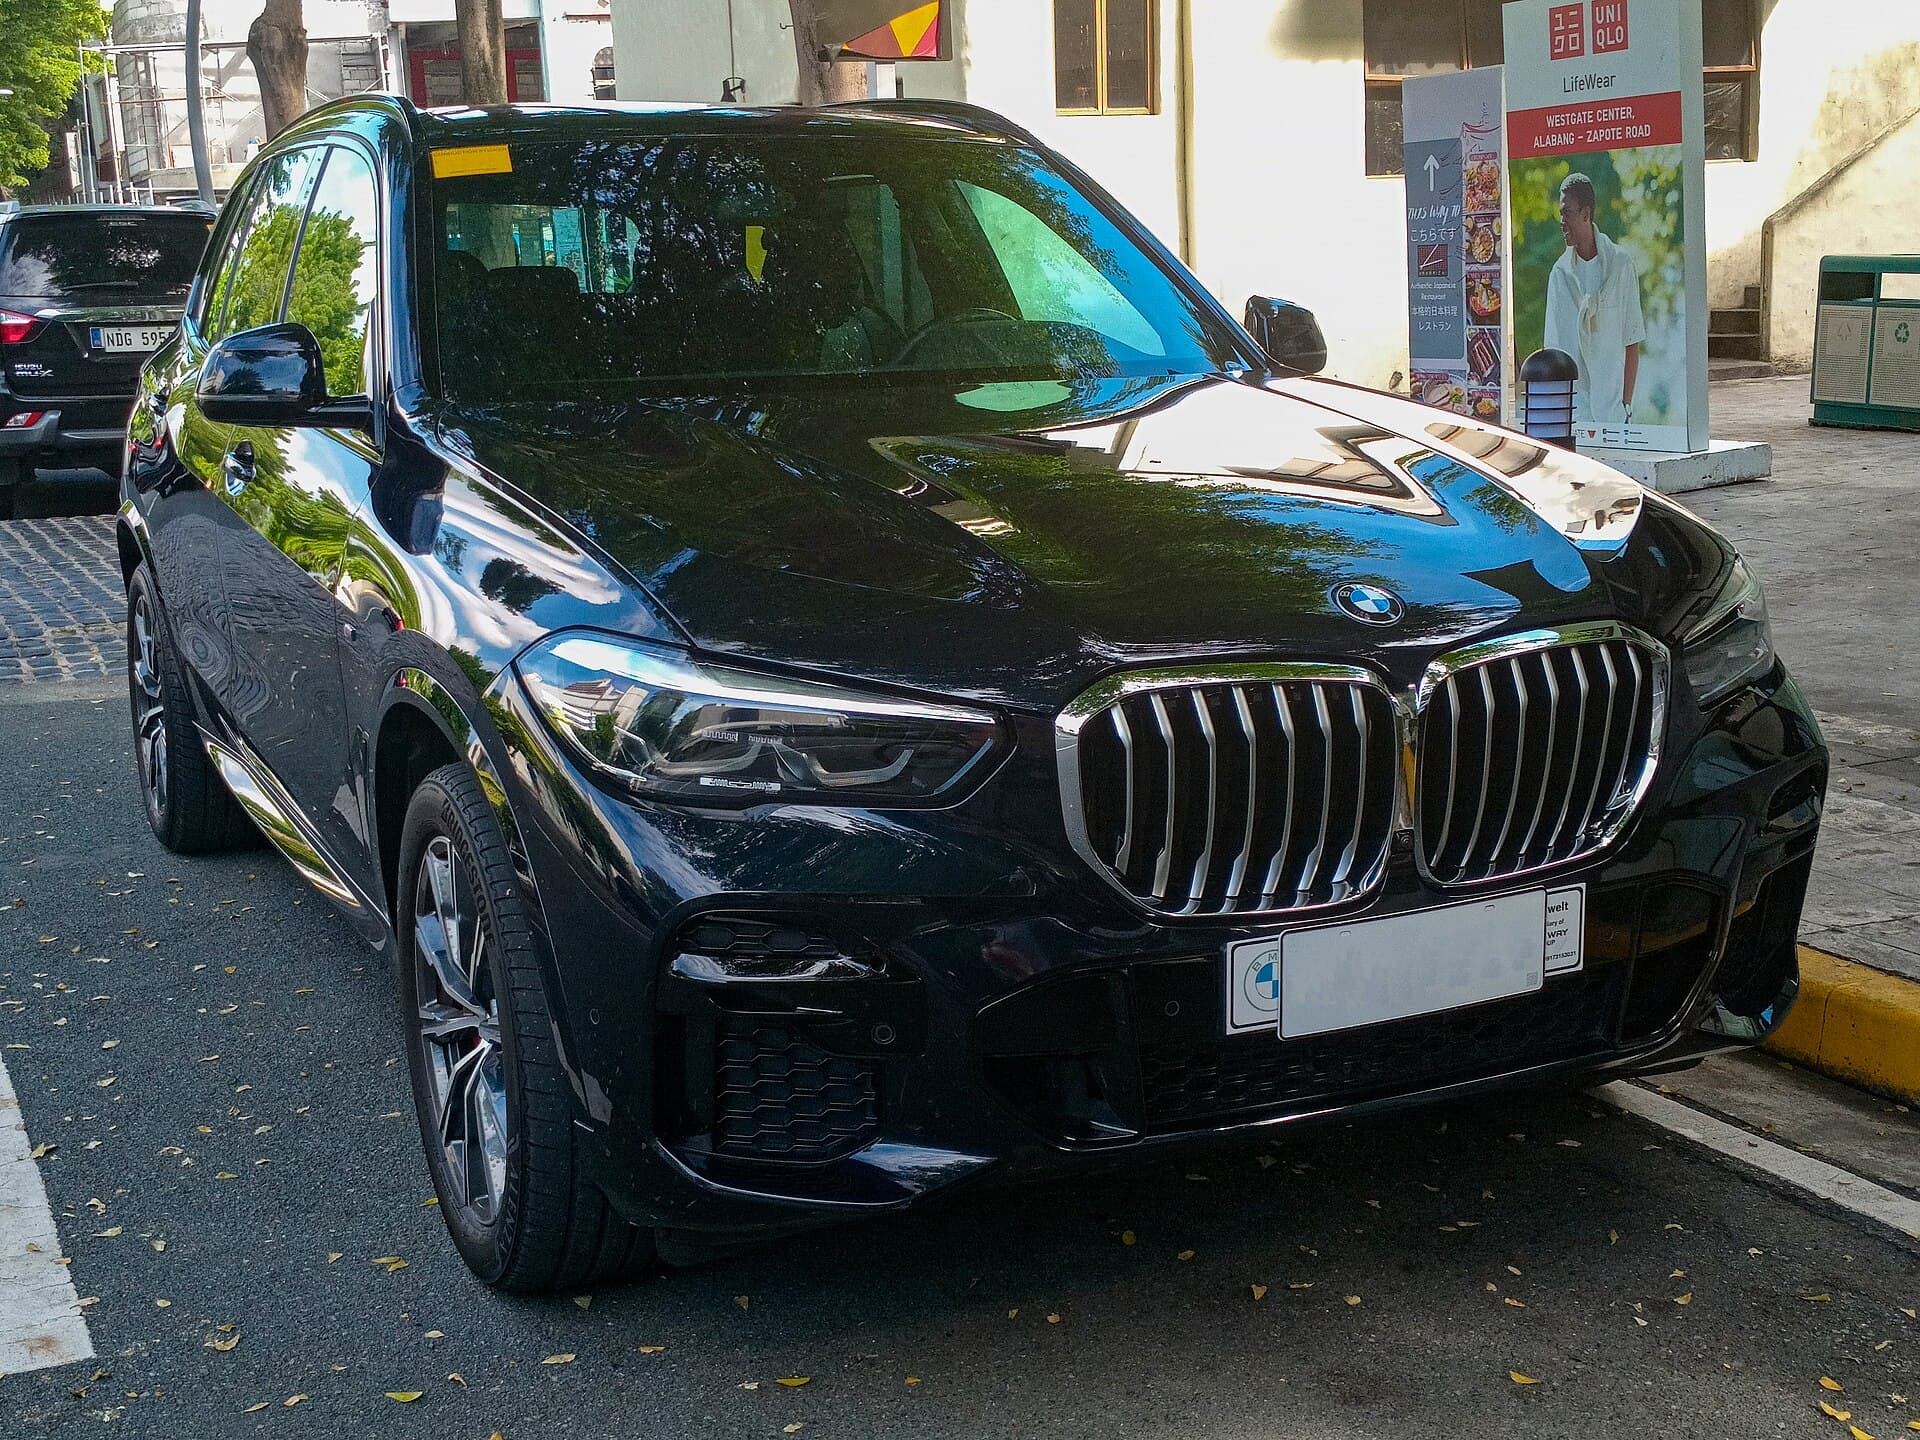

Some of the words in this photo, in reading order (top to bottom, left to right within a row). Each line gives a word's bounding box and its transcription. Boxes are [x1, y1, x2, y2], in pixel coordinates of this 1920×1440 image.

[1596, 3, 1621, 24] UNI
[1596, 26, 1624, 49] QLO
[1563, 73, 1616, 93] LifeWear
[1546, 110, 1594, 128] WESTGATE
[1596, 106, 1635, 122] CENTER,
[1534, 132, 1575, 148] ALABANG
[1587, 127, 1622, 143] ZAPOTE
[1626, 124, 1651, 138] ROAD
[1411, 228, 1456, 242] こちらです
[1418, 321, 1452, 331] レストラン
[107, 333, 132, 346] NDG
[1547, 901, 1569, 913] welt
[1547, 929, 1568, 938] WAY
